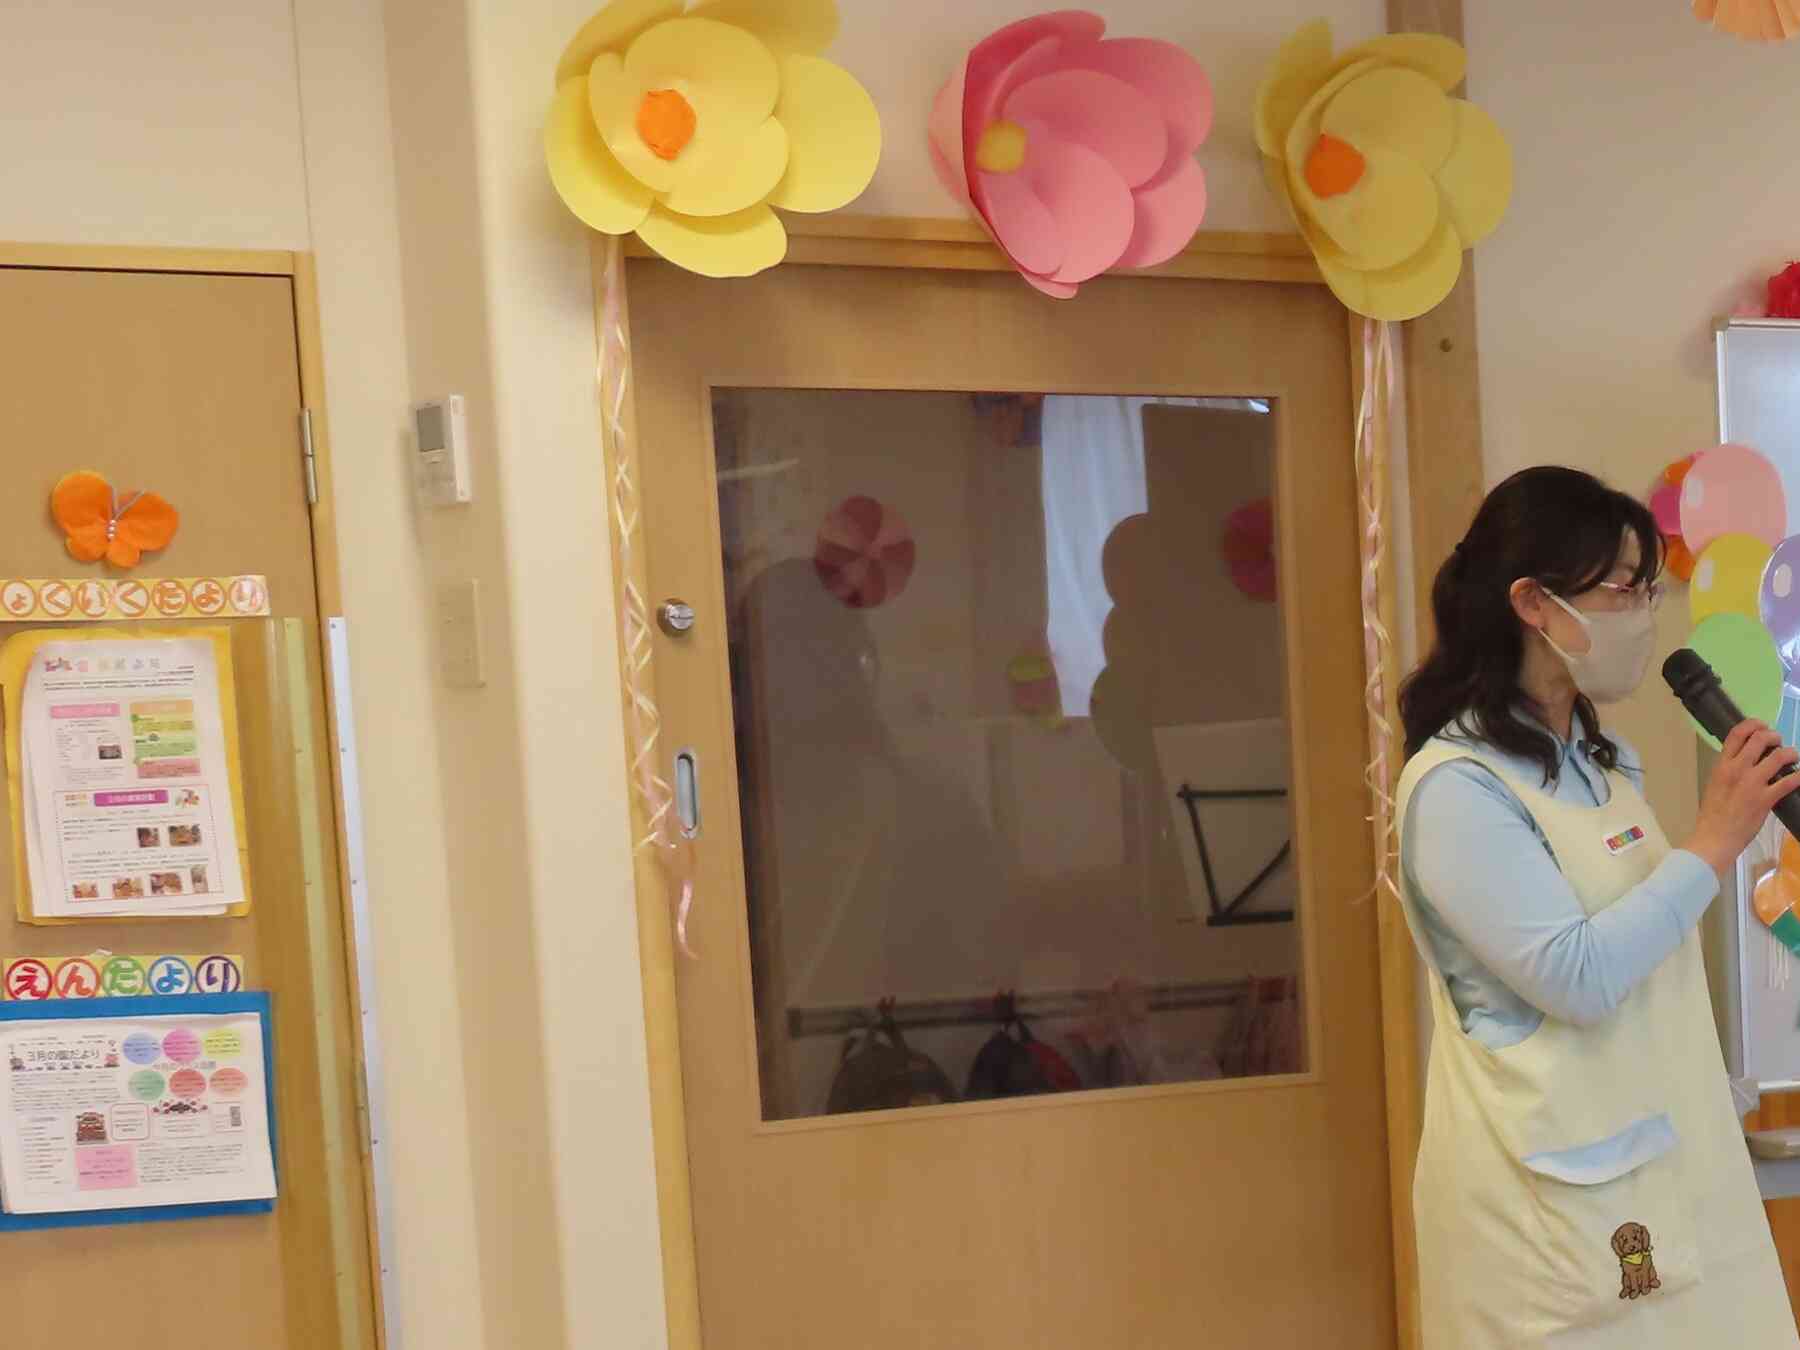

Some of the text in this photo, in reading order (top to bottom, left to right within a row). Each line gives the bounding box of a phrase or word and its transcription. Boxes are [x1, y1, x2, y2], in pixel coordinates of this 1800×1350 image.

[15, 961, 231, 999] えんだより
